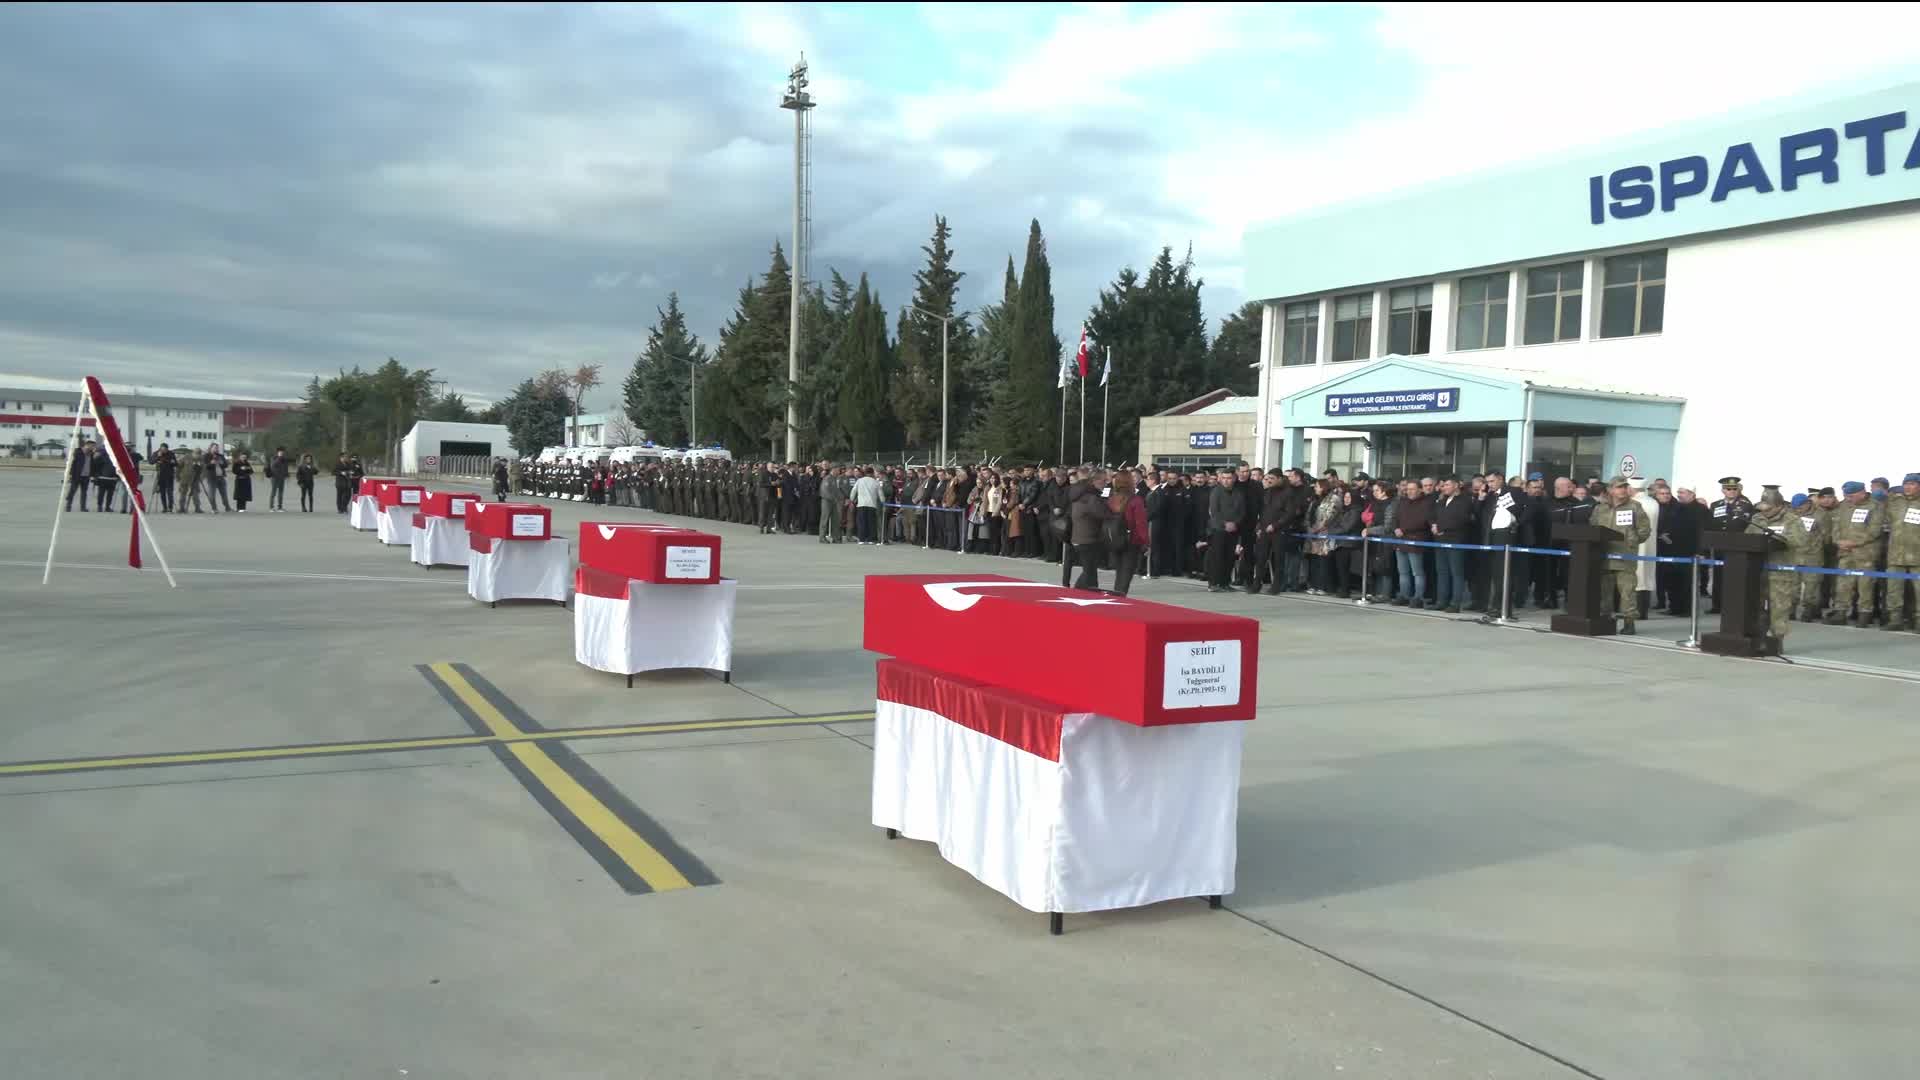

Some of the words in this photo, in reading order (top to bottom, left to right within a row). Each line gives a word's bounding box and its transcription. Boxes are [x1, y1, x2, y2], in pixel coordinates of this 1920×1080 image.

[1589, 110, 1920, 226] ISPART
[1352, 396, 1373, 404] HATLAR
[1374, 394, 1394, 403] GELEN
[1395, 393, 1415, 402] YOLCU
[1623, 461, 1634, 472] 25
[1191, 646, 1216, 656] ŞEHİT
[1192, 665, 1225, 675] BAYDİLLİ
